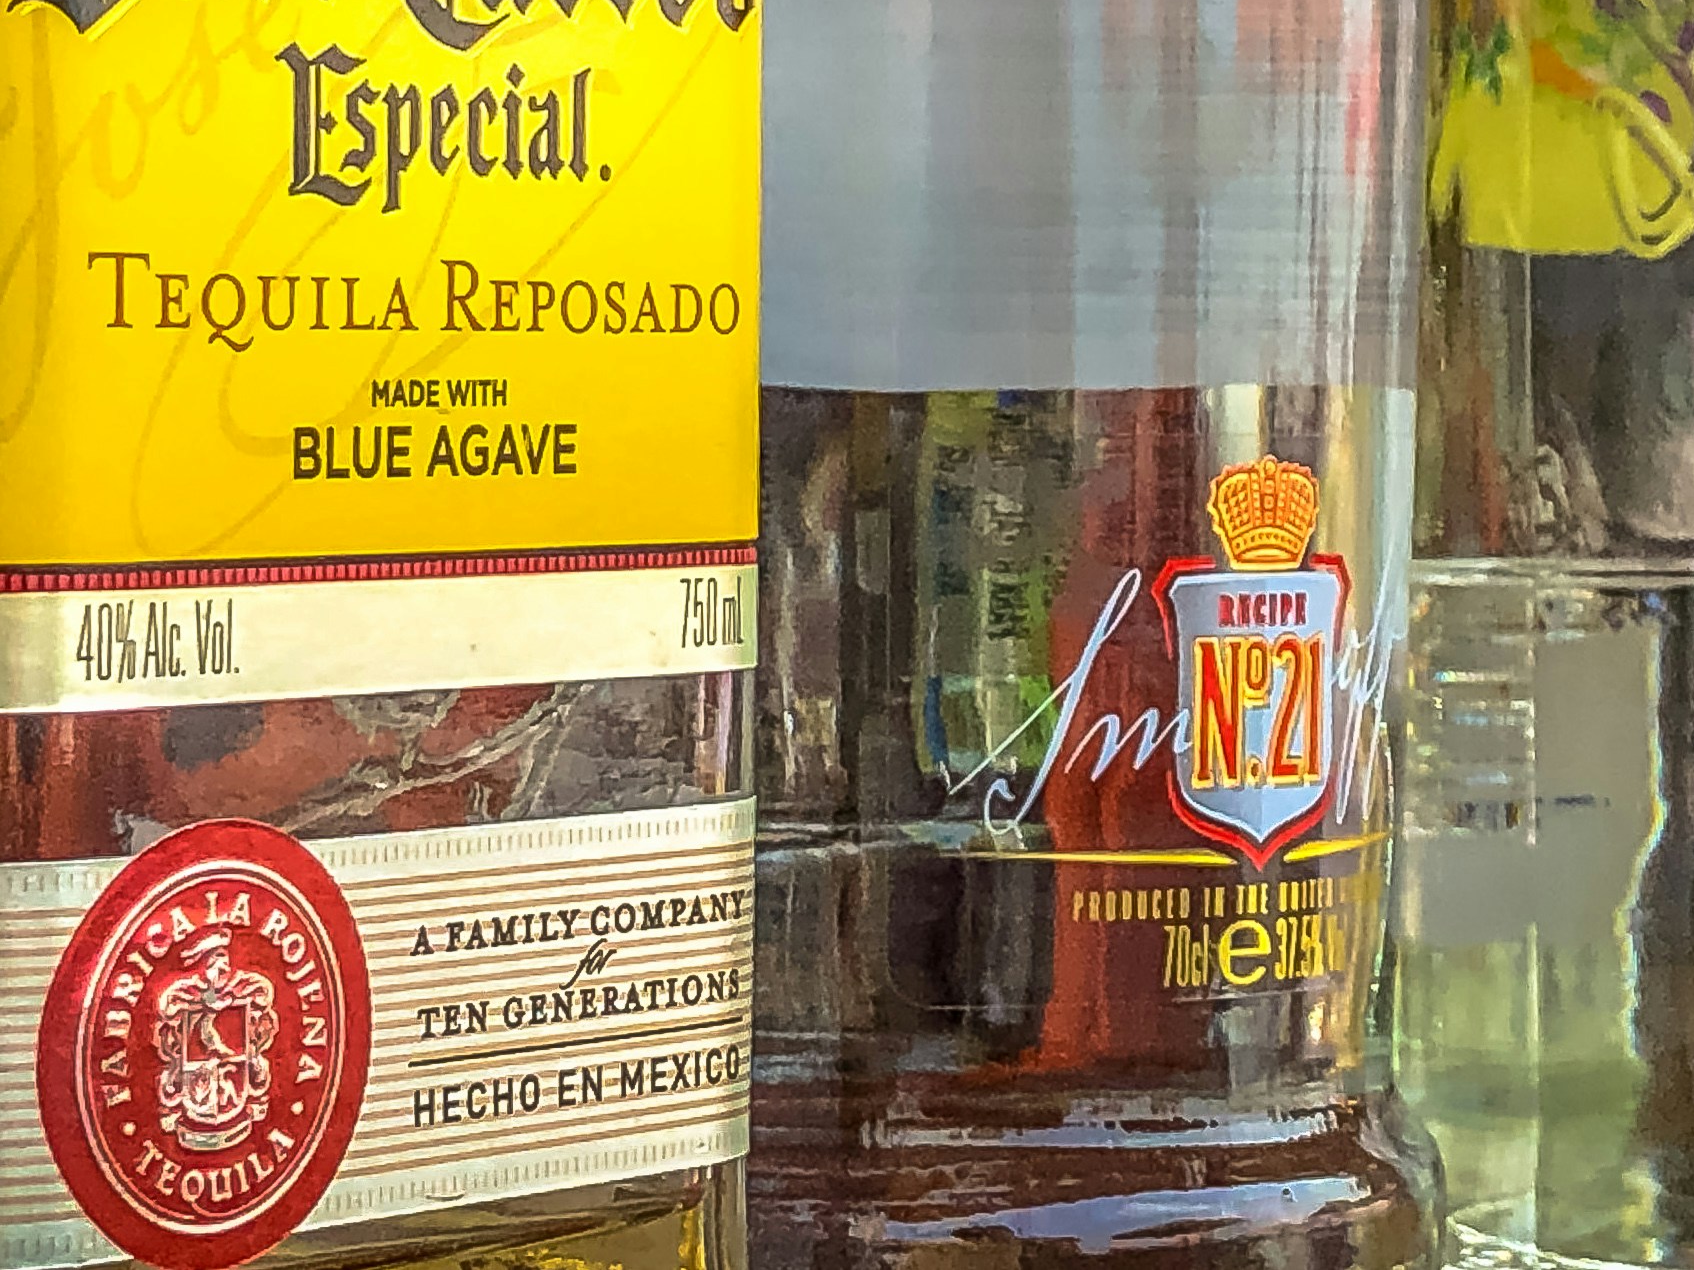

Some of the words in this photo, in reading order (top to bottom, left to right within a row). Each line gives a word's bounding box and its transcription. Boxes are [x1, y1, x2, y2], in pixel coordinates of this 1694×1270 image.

[276, 43, 612, 214] Especial.
[88, 252, 419, 352] TEQUILA
[441, 260, 741, 336] REPOSADO
[371, 379, 440, 408] MADE
[448, 379, 508, 408] WITH
[293, 425, 411, 480] BLUE
[427, 423, 578, 477] AGAVE
[75, 602, 137, 685] 40%
[142, 601, 187, 680] Alc.
[194, 597, 241, 676] Vol.
[680, 577, 719, 651] 750
[1218, 591, 1309, 629] RECIPE
[410, 928, 434, 957] A
[446, 907, 578, 954] FAMILY
[591, 889, 746, 941] COMPANY
[1073, 887, 1190, 922] PRODUCED
[1203, 886, 1226, 918] IN
[1236, 882, 1269, 914] THE
[562, 937, 616, 989] for
[1219, 920, 1272, 985] e
[101, 906, 194, 1108] FABRICA
[204, 889, 252, 928] LA
[262, 907, 331, 1086] ROJENA
[418, 999, 490, 1040] TEN
[504, 968, 742, 1031] GENERATIONS
[413, 1074, 541, 1128] HECHO
[558, 1066, 603, 1108] EN
[620, 1043, 743, 1100] MEXICO
[134, 1128, 299, 1205] TEQUILA
